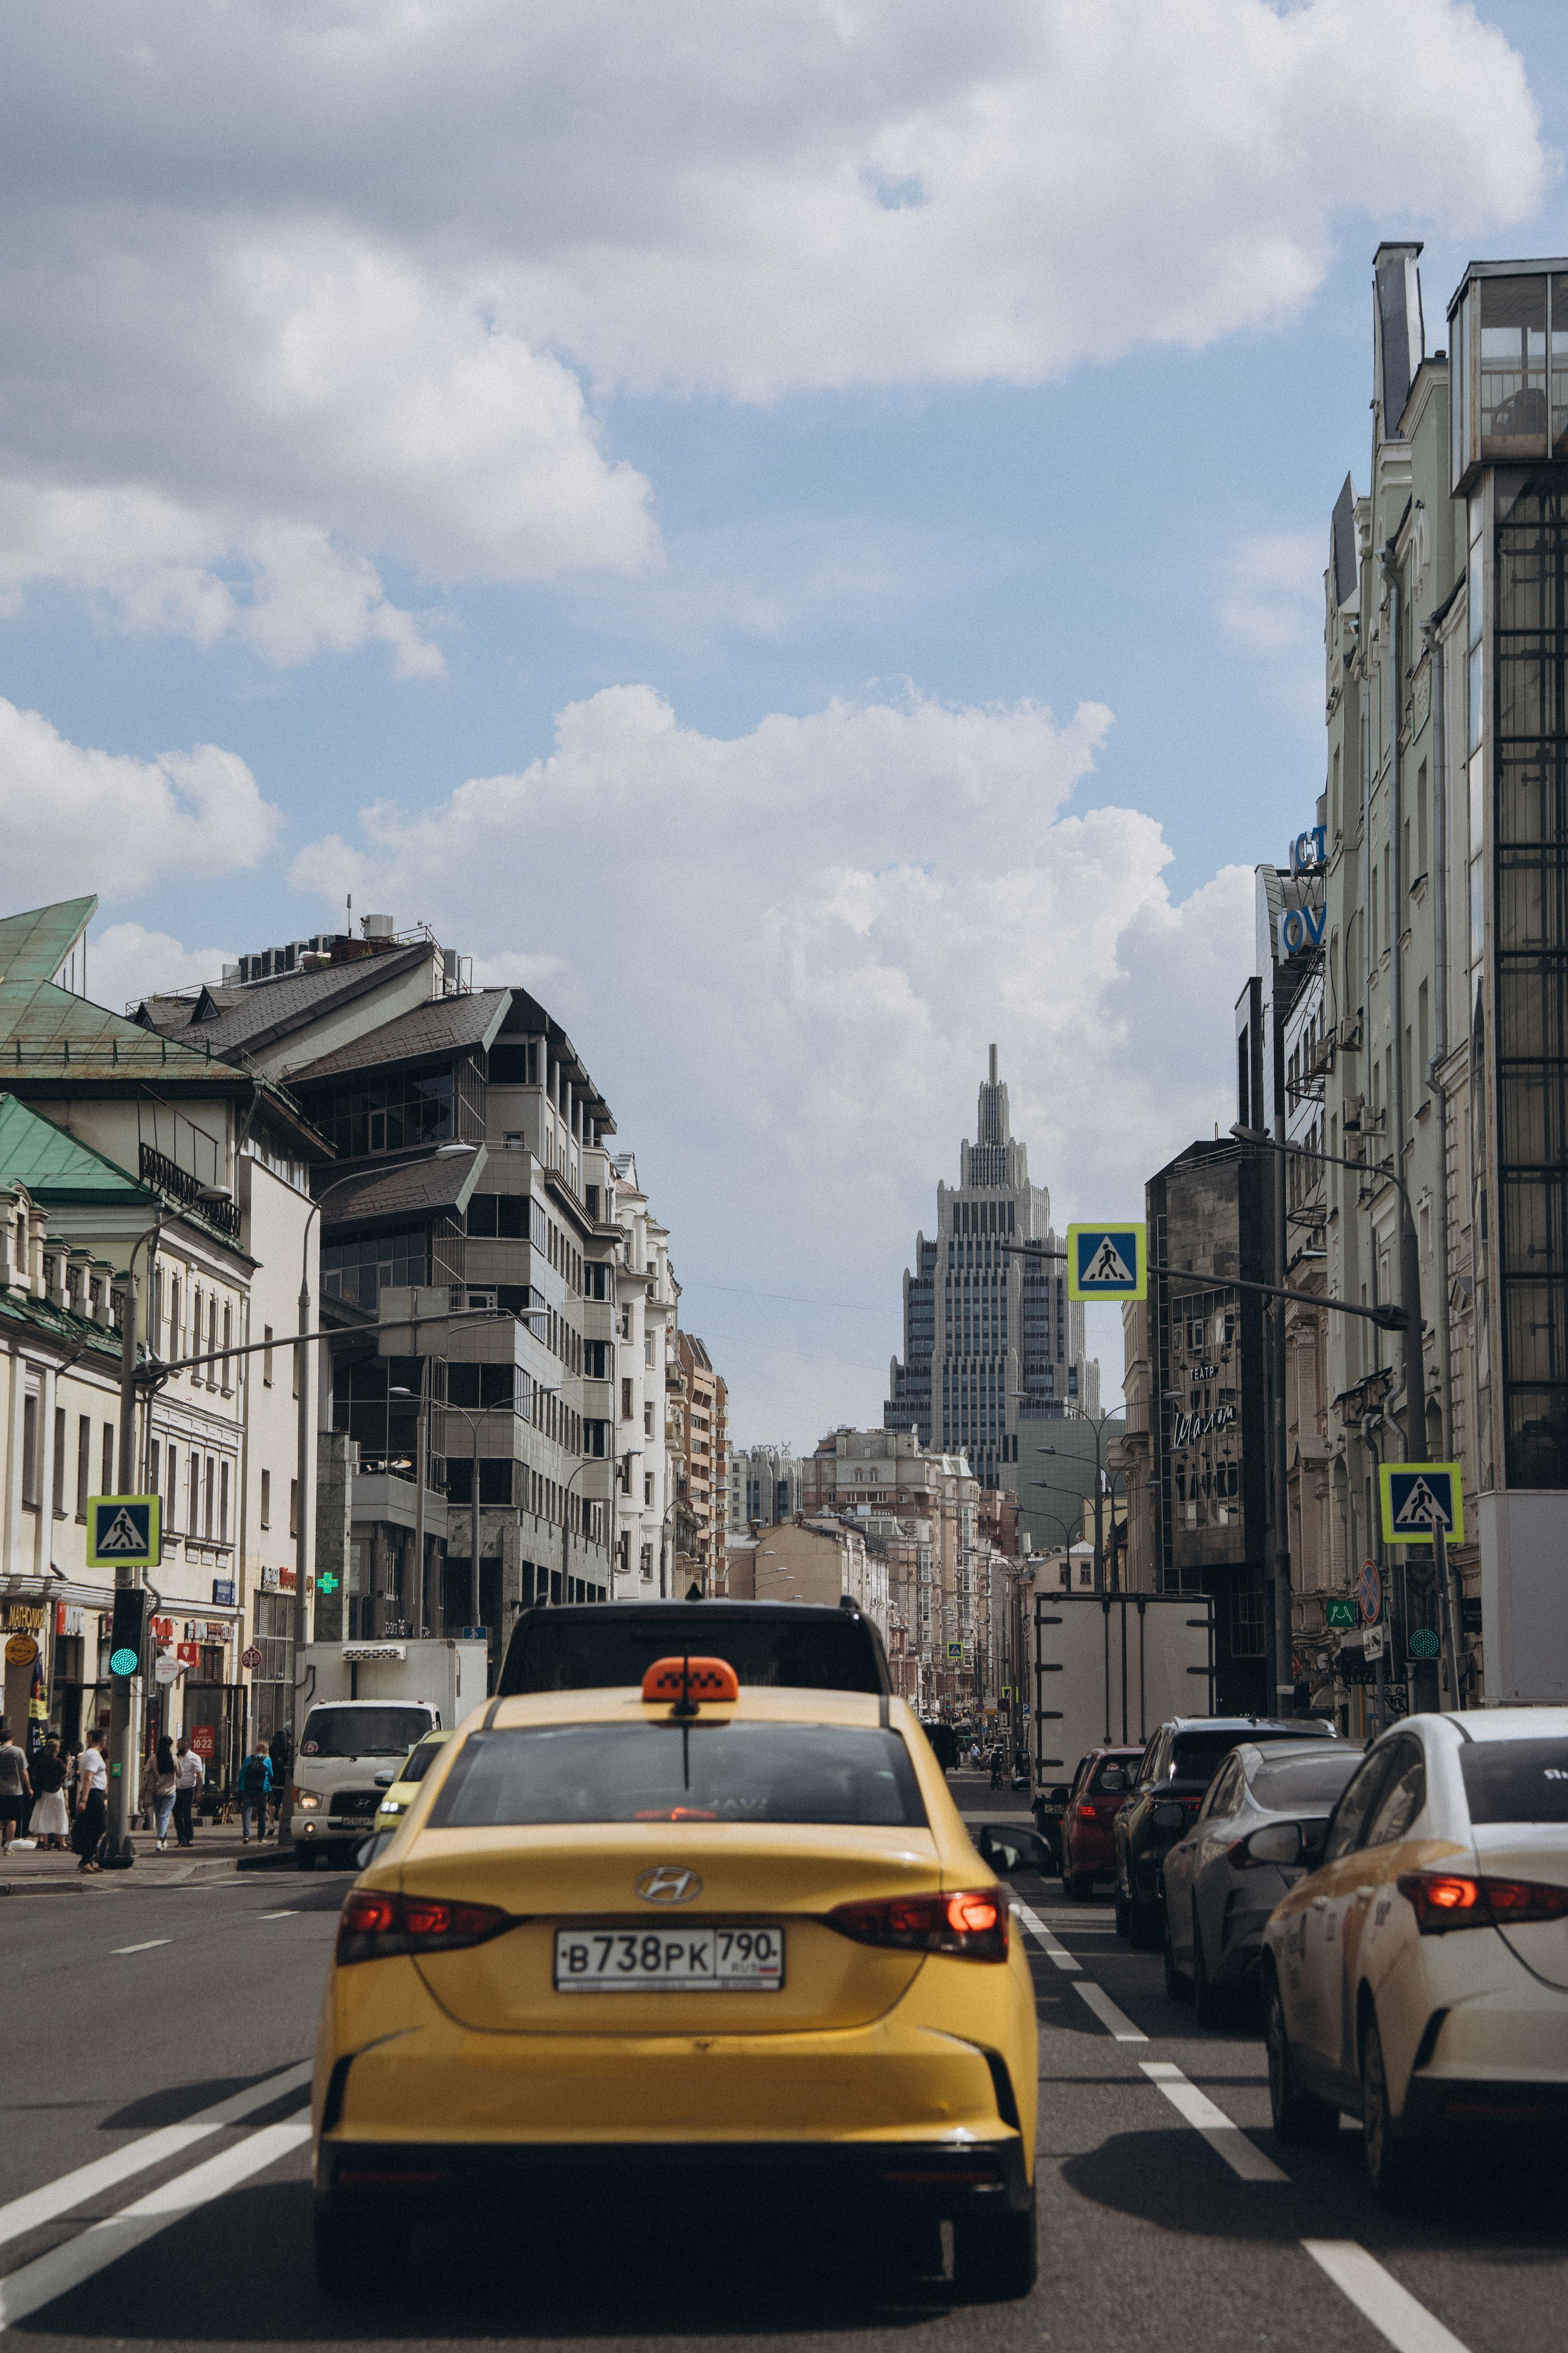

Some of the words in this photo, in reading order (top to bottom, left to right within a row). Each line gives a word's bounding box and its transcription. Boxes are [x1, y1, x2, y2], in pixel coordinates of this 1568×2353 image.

[1189, 1366, 1214, 1381] ТЕАТР
[9, 1606, 43, 1628] МАГНОЛИЯ
[1022, 1704, 1028, 1713] P
[568, 1935, 709, 1973] В738РК
[718, 1932, 772, 1961] 790
